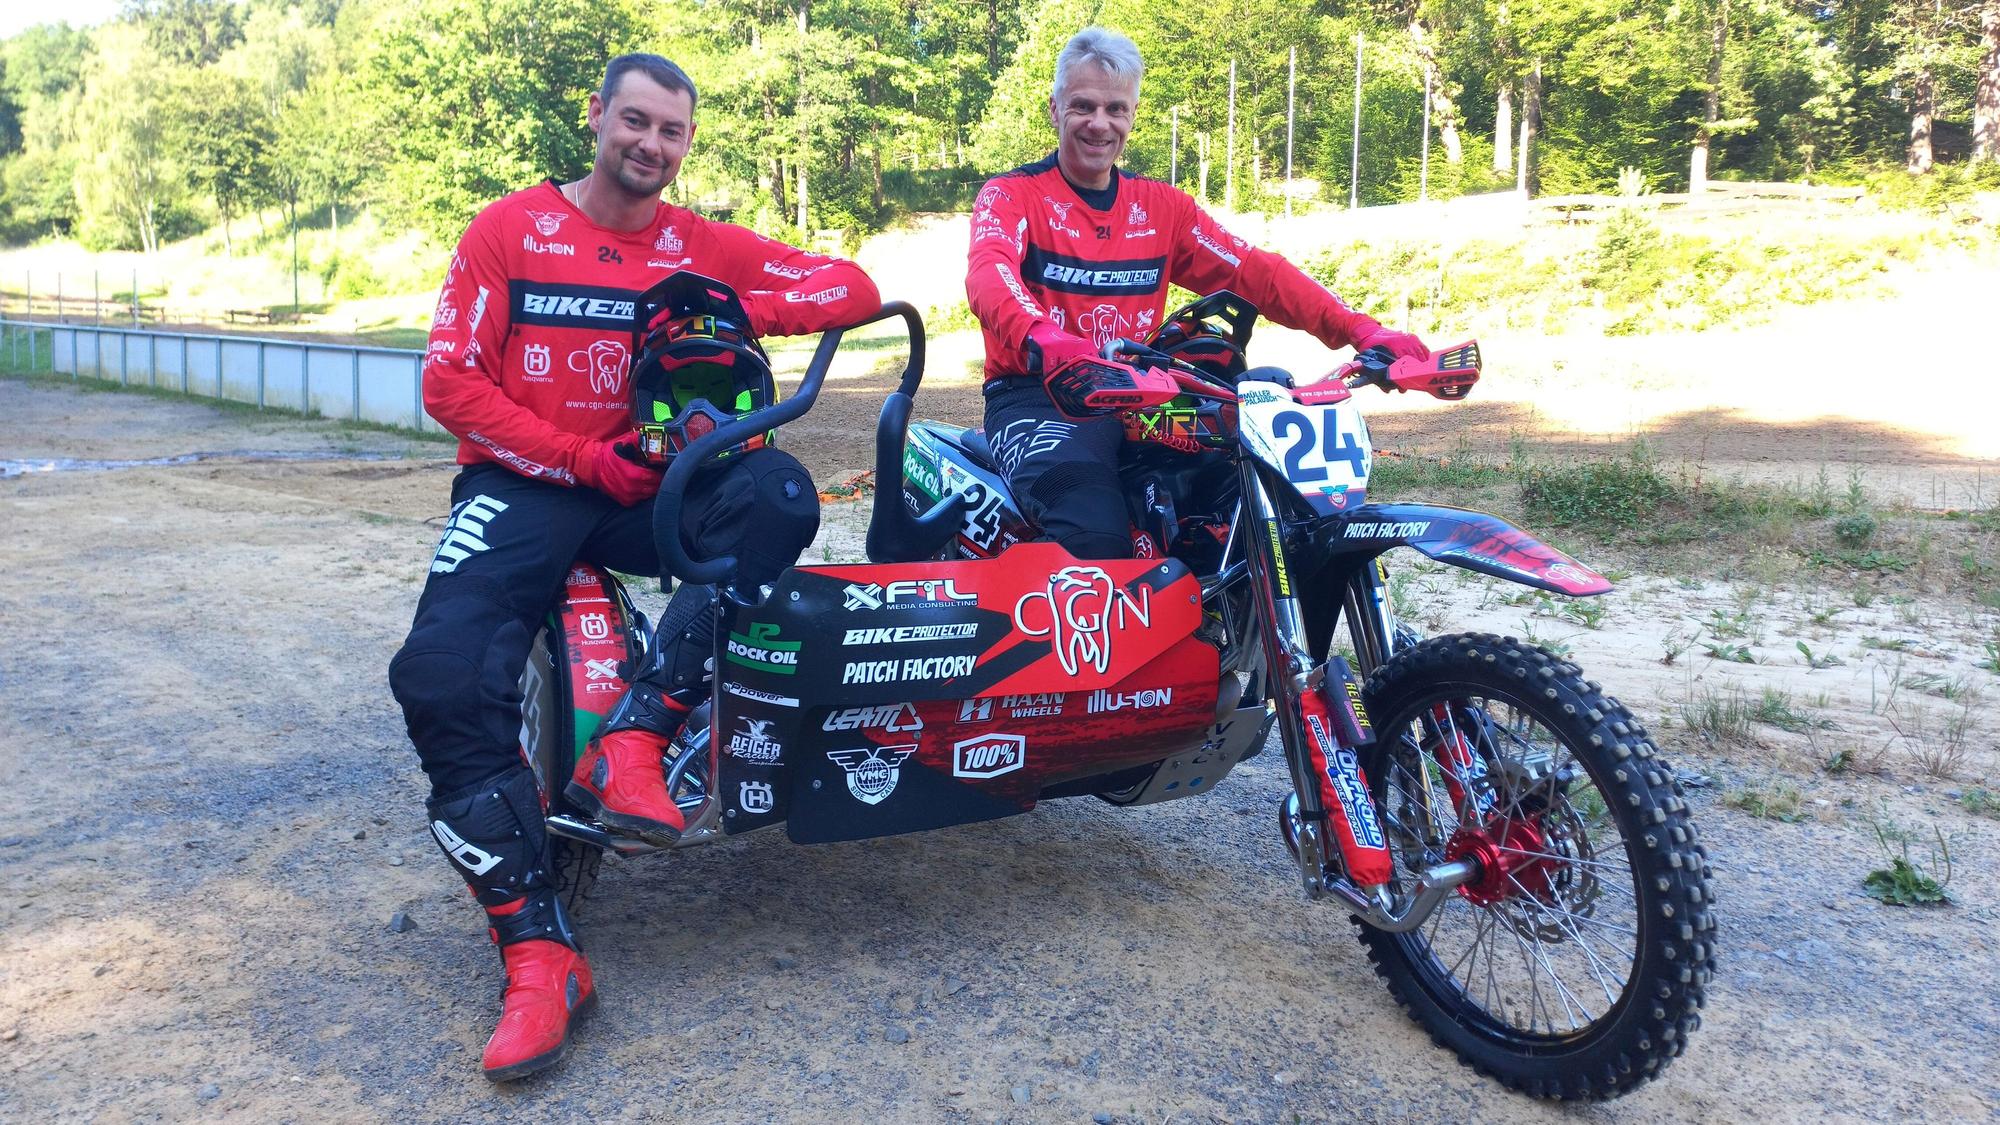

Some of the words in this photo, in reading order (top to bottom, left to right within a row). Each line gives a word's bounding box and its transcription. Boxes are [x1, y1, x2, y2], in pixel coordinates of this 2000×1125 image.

[598, 246, 623, 264] 24
[1243, 390, 1270, 400] MÜLLER
[1272, 409, 1365, 482] 24
[1343, 523, 1379, 538] PATCH
[1376, 521, 1431, 538] FACTORY
[886, 579, 978, 603] FTL
[918, 600, 978, 609] CONSULTING
[728, 640, 769, 662] ROCK
[770, 652, 798, 665] OIL
[842, 660, 900, 684] PATCH
[902, 655, 977, 681] FACTORY
[586, 682, 621, 691] FTL
[1001, 692, 1066, 708] HAAN
[1345, 682, 1371, 728] REIGER
[1011, 704, 1063, 718] WHEELS
[731, 735, 781, 757] REIGER
[964, 743, 1016, 770] 100%
[857, 769, 888, 781] VMC
[850, 786, 865, 800] SIDE
[879, 780, 896, 798] CARS
[1337, 751, 1384, 846] OFFROAD
